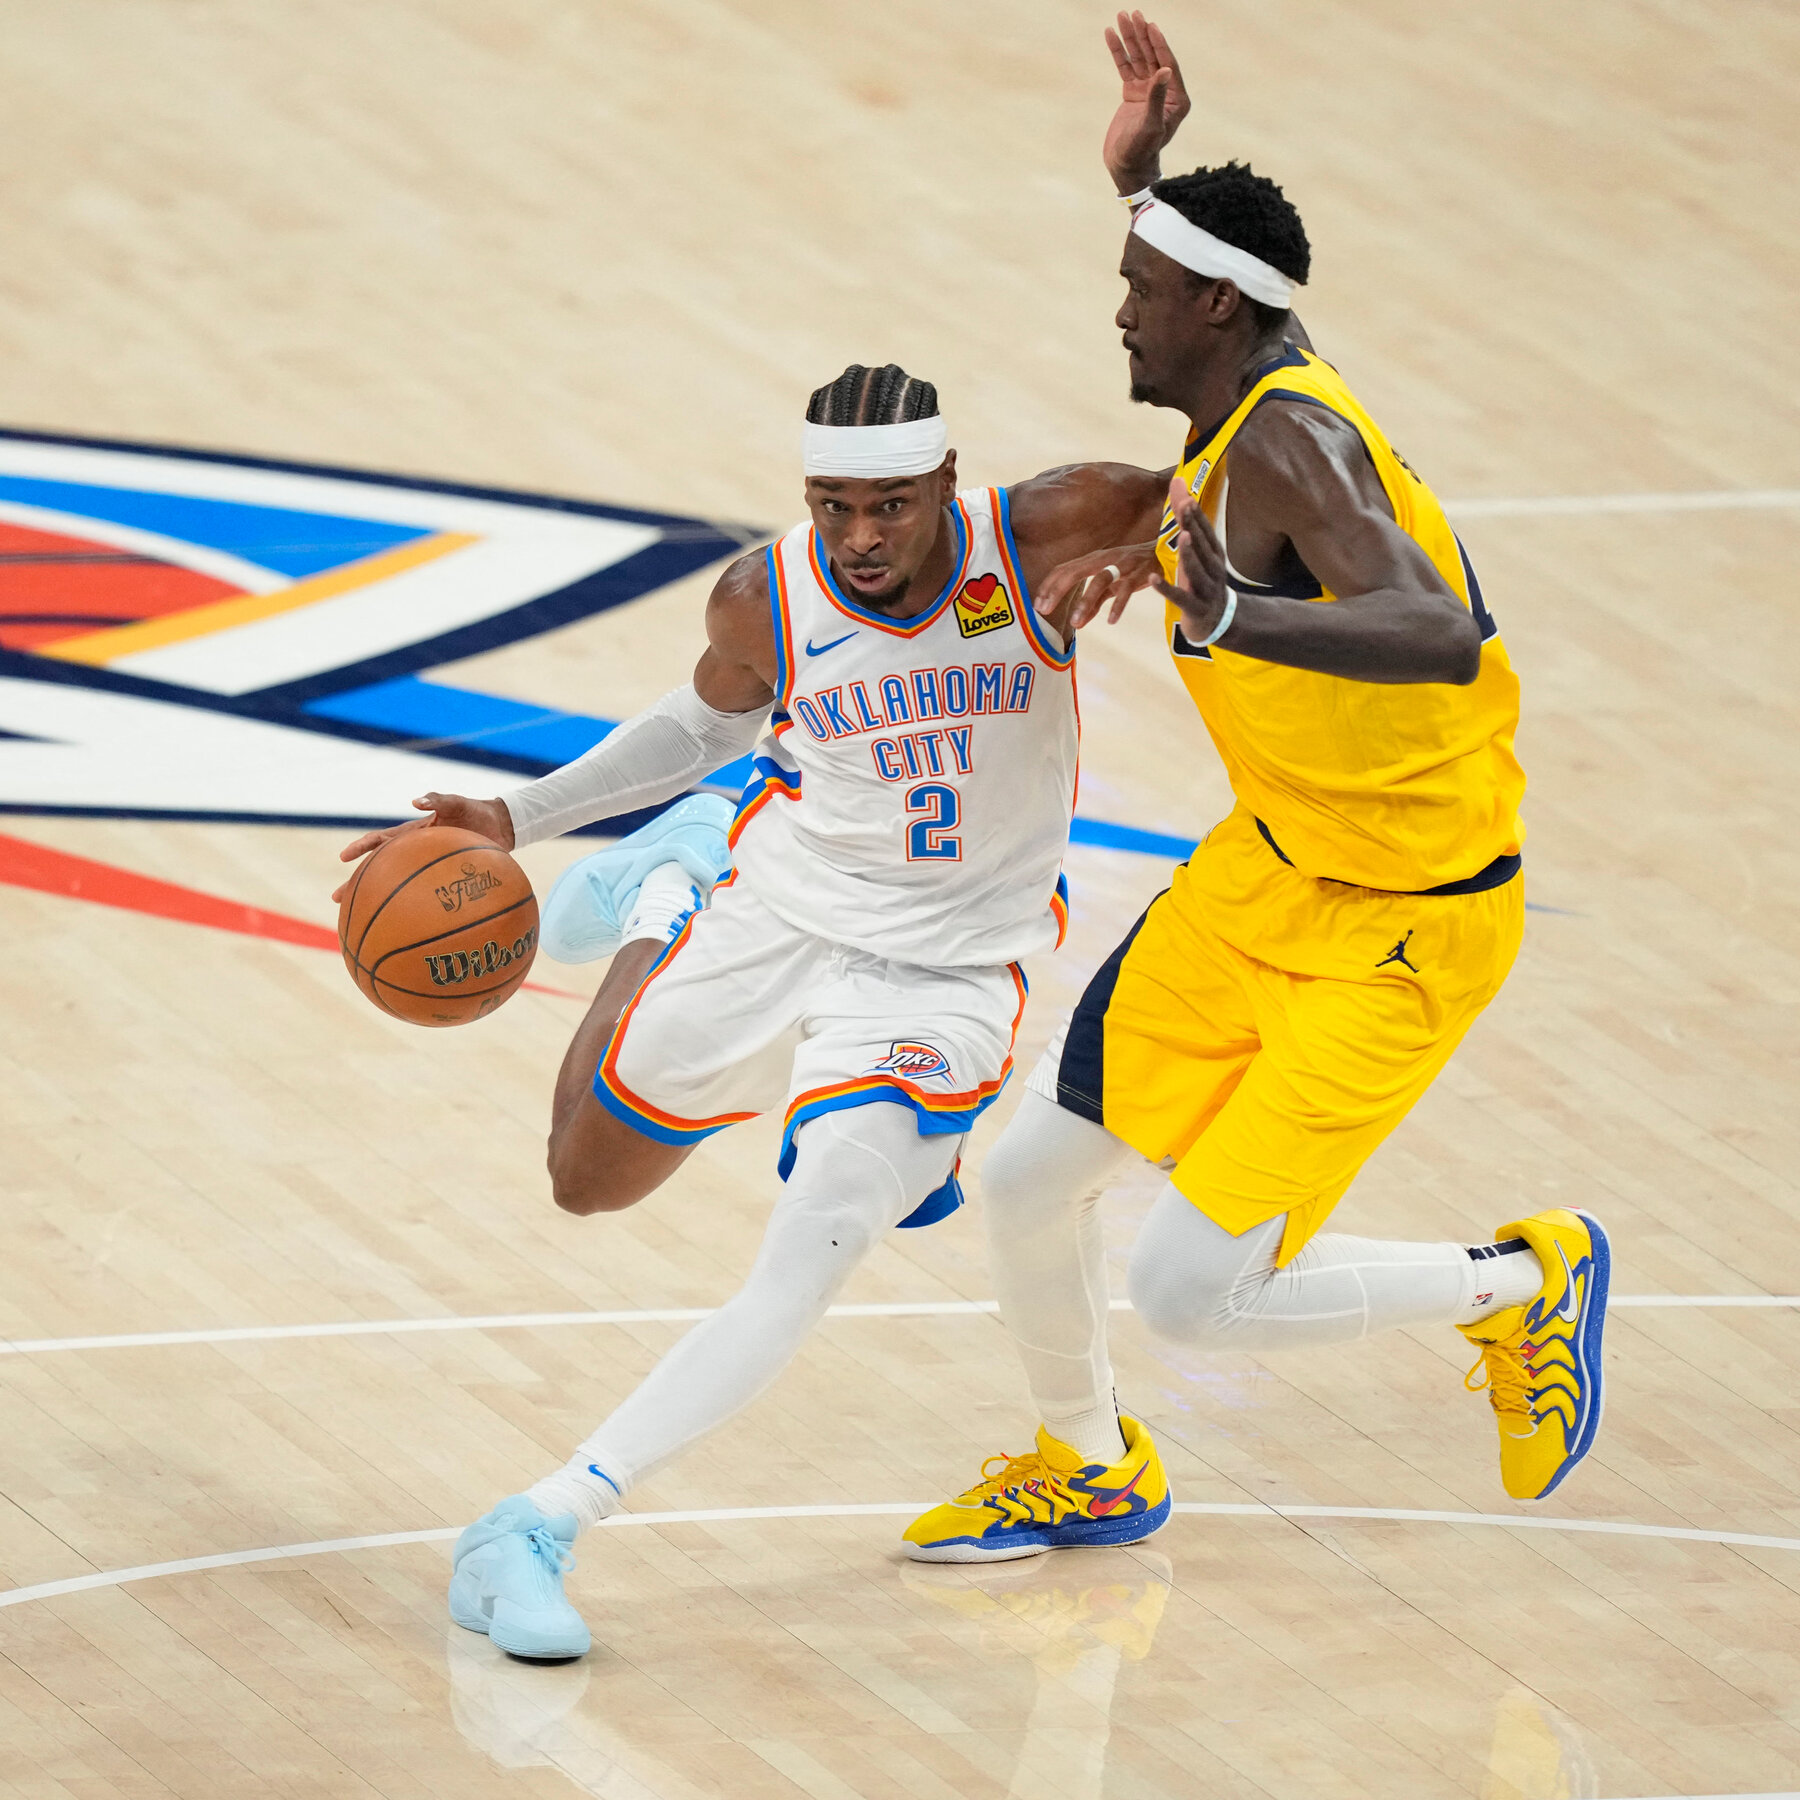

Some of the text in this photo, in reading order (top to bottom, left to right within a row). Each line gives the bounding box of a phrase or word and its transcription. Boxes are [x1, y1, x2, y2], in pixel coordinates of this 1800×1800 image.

[794, 662, 1035, 742] OKLAHOMA
[871, 725, 973, 782] CITY
[905, 781, 962, 862] 2
[449, 870, 502, 912] Finals
[424, 926, 536, 986] Wilson
[875, 1052, 939, 1069] OKC
